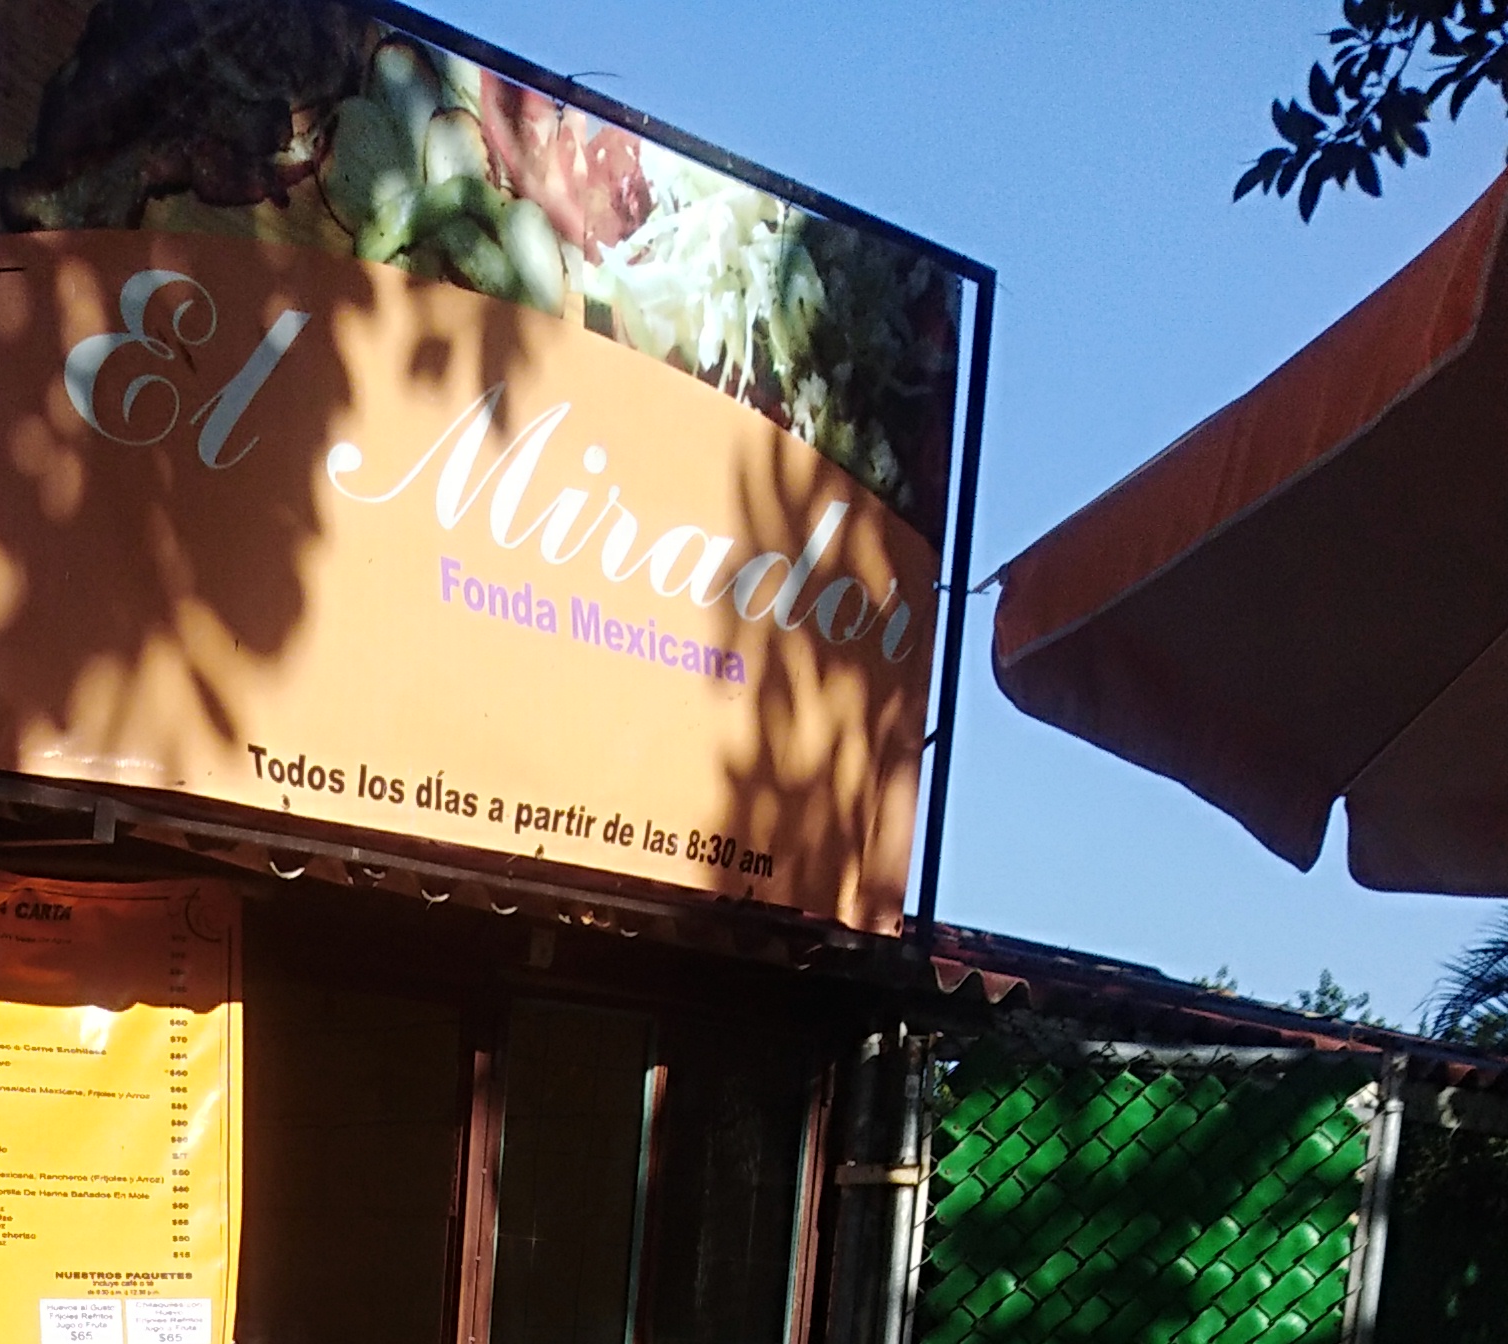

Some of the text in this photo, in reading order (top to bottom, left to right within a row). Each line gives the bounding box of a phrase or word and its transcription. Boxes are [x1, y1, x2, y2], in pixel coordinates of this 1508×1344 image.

[65, 270, 915, 664] El Mirador
[440, 557, 746, 684] Fonda Mexicana
[247, 743, 345, 794] Todos
[357, 764, 405, 804] los
[487, 797, 504, 823] a
[515, 801, 596, 838] partir
[602, 813, 634, 847] de
[642, 819, 678, 855] las
[685, 830, 737, 868] 8:30
[739, 848, 773, 878] am
[15, 902, 72, 920] CARTA
[56, 1271, 192, 1280] NUESTROS PAQUETES
